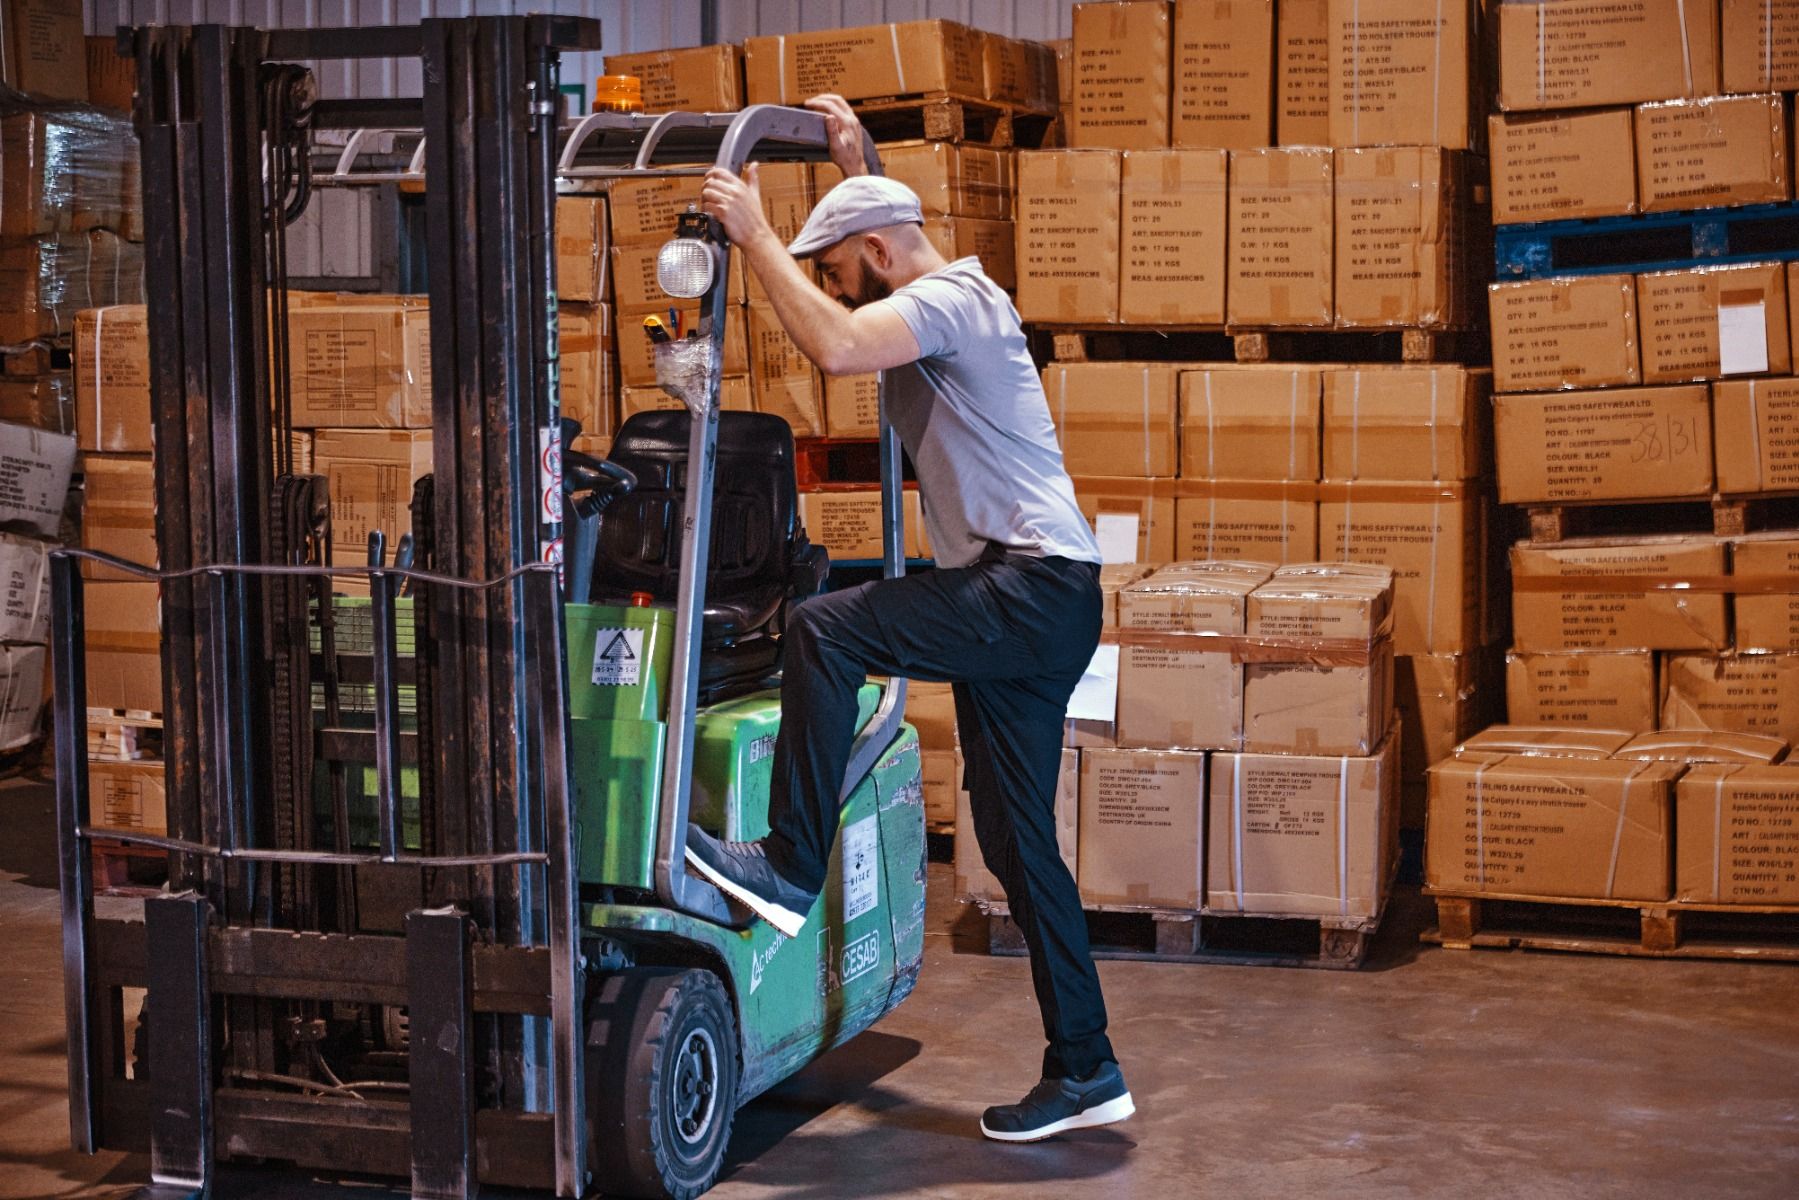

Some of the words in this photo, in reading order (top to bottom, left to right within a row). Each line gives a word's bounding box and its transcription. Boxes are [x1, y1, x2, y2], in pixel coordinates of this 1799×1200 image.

[1575, 5, 1627, 14] SAFETYWEAR
[1381, 19, 1432, 29] SAFETYWEAR
[1573, 55, 1600, 63] BLACK
[1543, 404, 1581, 413] STERLING
[1582, 400, 1635, 411] SAFETYWEAR
[1545, 429, 1557, 437] PO
[1585, 451, 1611, 460] BLACK
[1230, 523, 1281, 532] SAFETYWEAR
[1375, 525, 1427, 533] SAFETYWEAR
[1600, 604, 1626, 612] BLACK
[1466, 782, 1508, 791] STRLING
[1509, 784, 1567, 795] SAFETYWEAR
[1732, 792, 1776, 801] STERLING
[1490, 796, 1515, 806] Calgary
[1526, 799, 1538, 808] way
[1466, 808, 1477, 816] PO
[1758, 804, 1783, 814] Calgary
[1732, 818, 1744, 826] PO
[1465, 835, 1503, 844] COOUR:
[1732, 832, 1749, 840] ART
[1785, 873, 1796, 881] 20
[1732, 887, 1750, 895] CTN
[842, 938, 878, 978] CESAB
